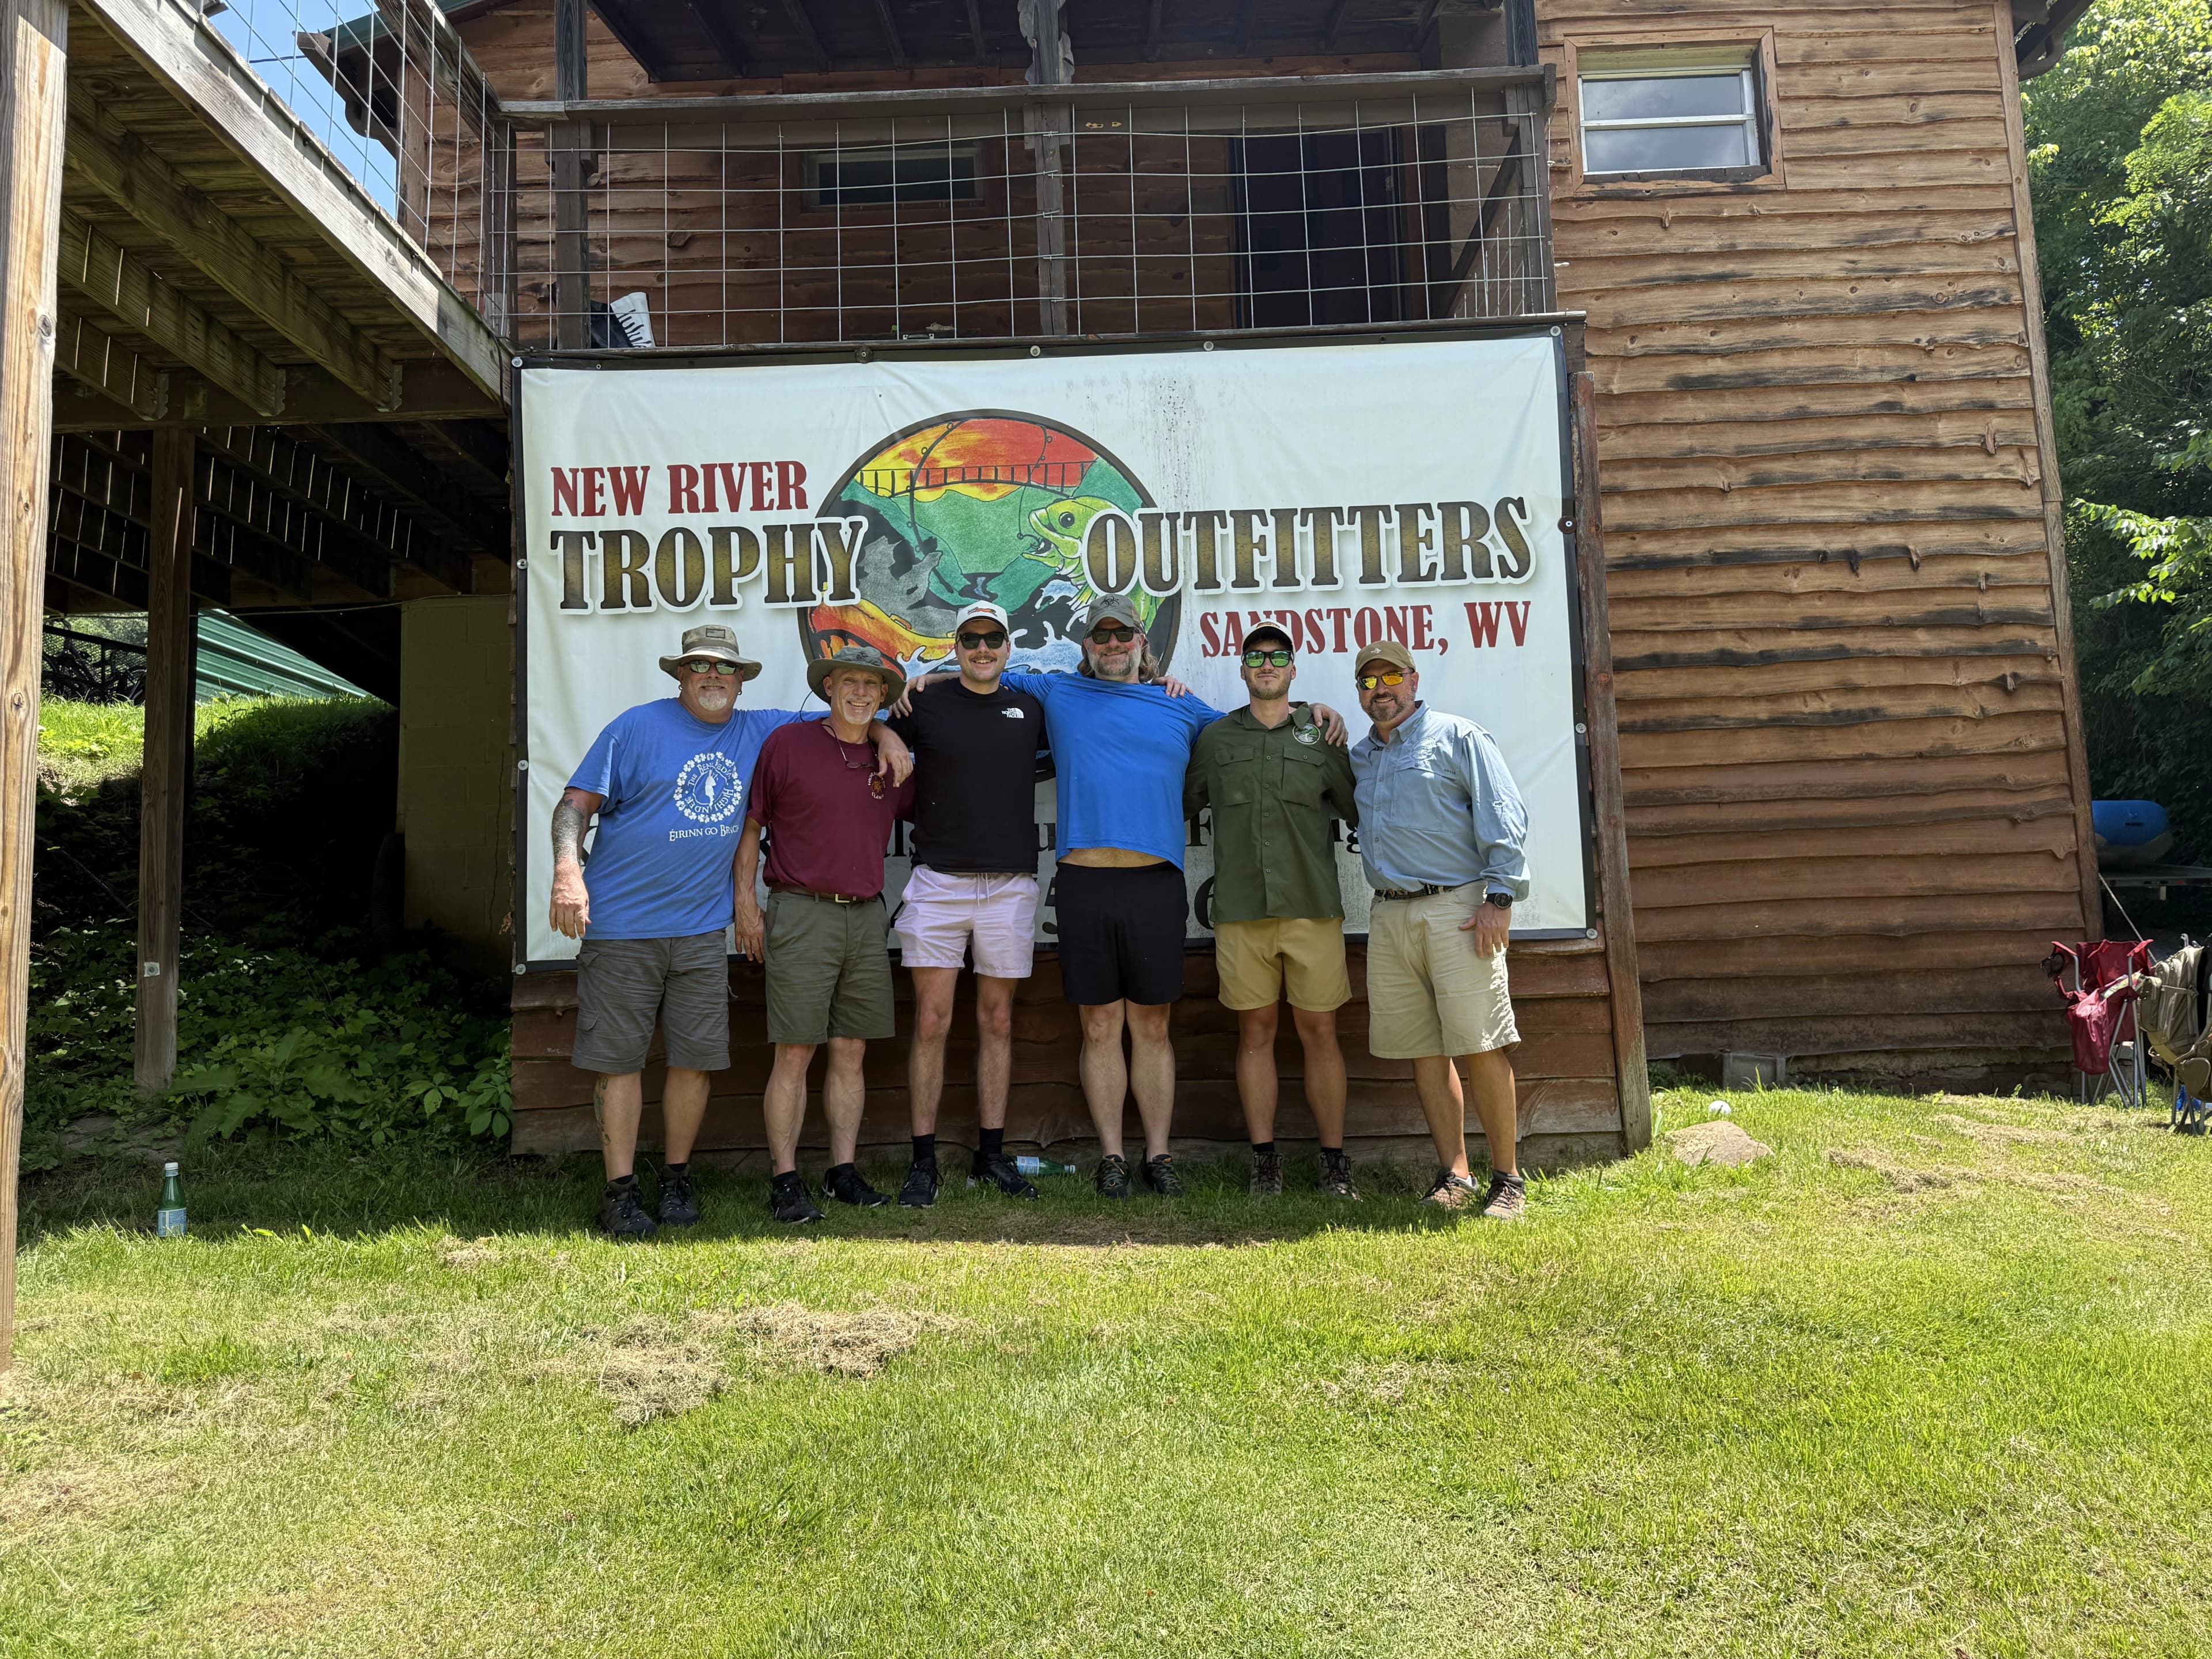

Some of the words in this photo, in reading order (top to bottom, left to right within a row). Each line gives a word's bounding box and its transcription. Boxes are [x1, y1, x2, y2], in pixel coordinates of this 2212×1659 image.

[551, 465, 650, 517] NEW
[667, 461, 808, 513] RIVER
[550, 521, 863, 610] TROPHY
[1087, 497, 1532, 594] OUTFITTERS
[1464, 601, 1531, 648] WV
[687, 773, 698, 786] THE
[669, 829, 703, 842] ÉIRINN
[704, 827, 718, 835] GO
